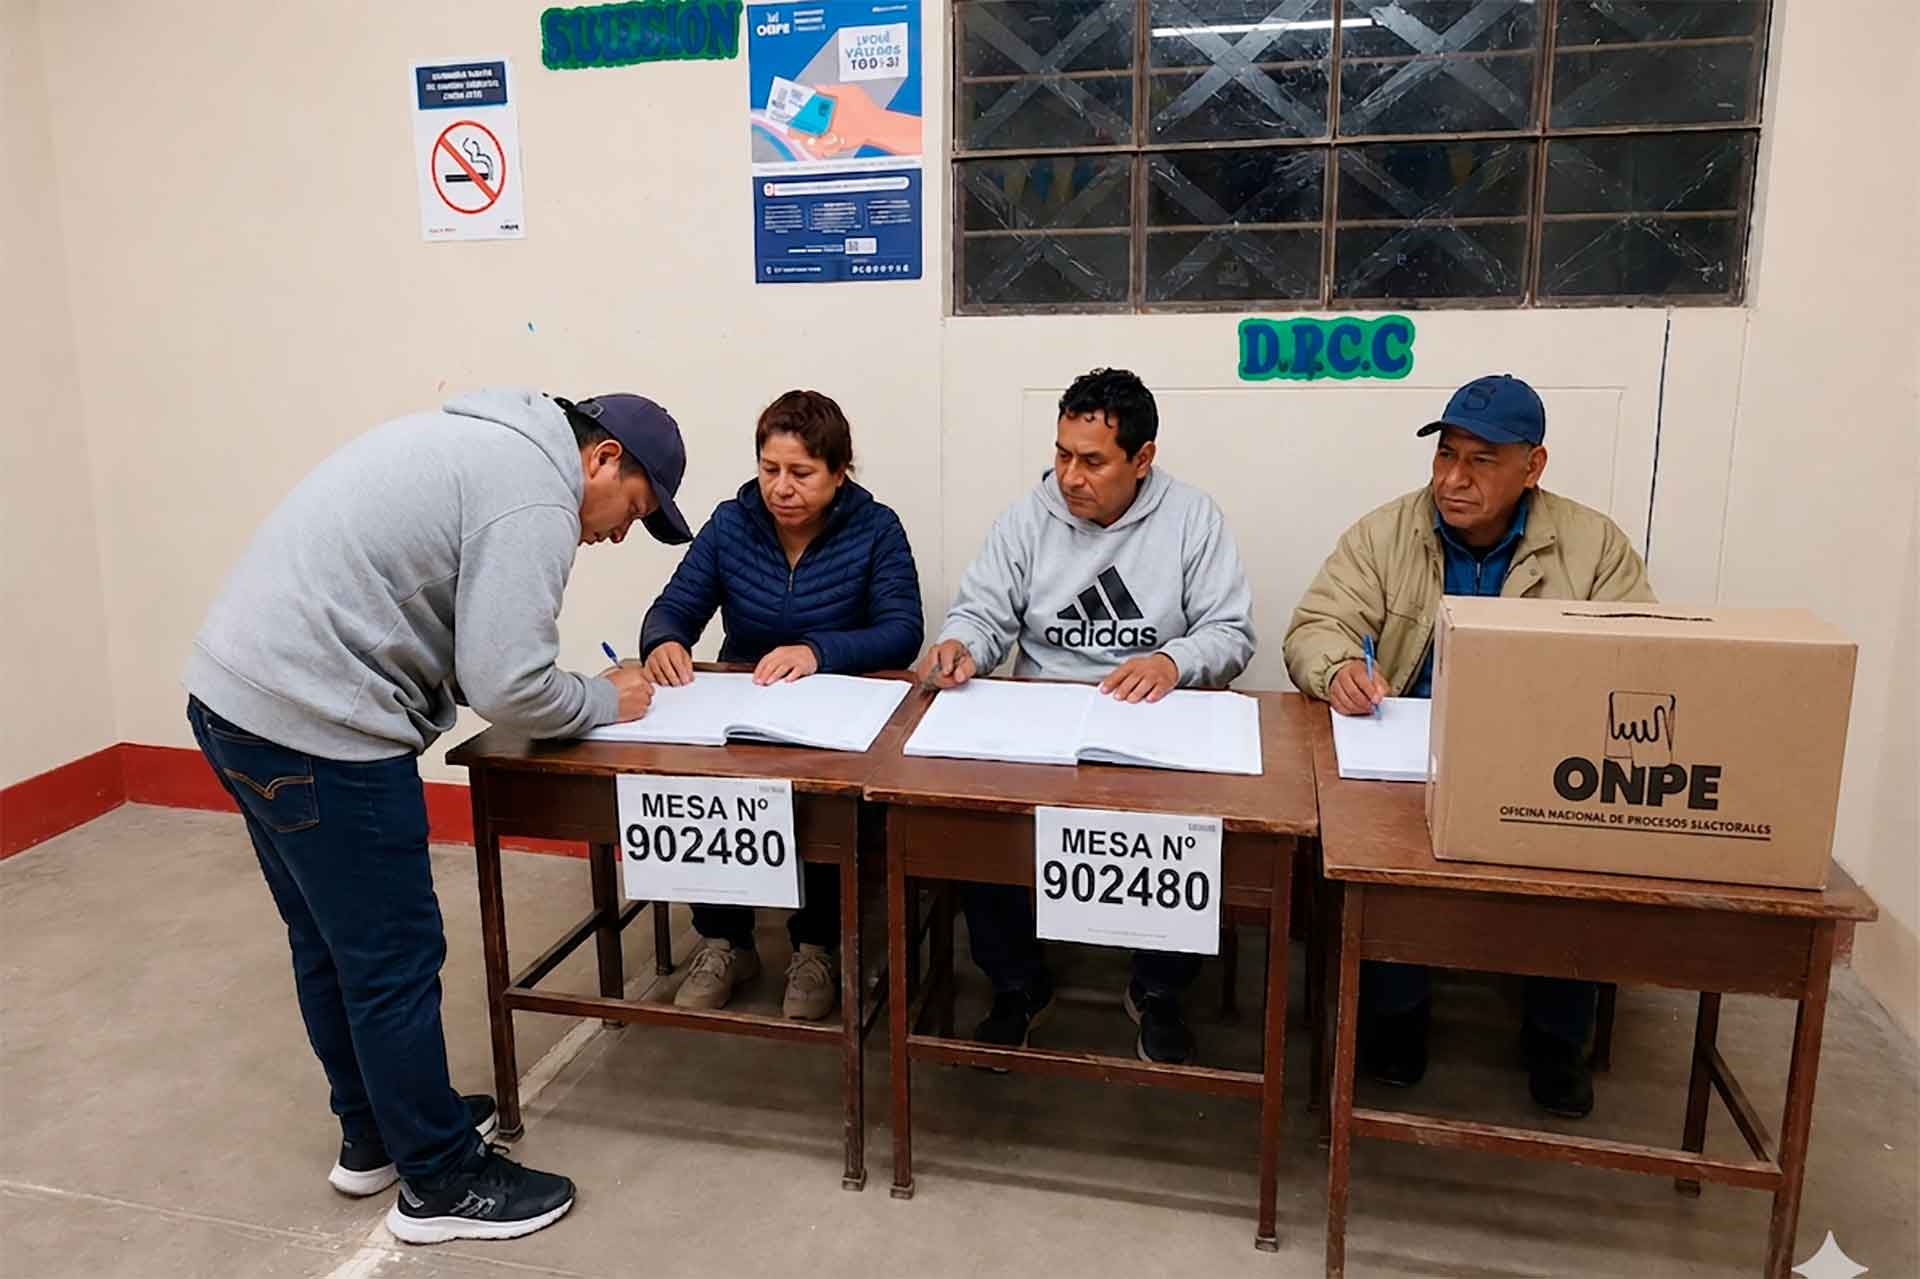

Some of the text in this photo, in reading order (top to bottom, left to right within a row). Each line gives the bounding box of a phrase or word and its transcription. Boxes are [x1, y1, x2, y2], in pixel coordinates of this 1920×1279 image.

[1045, 620, 1157, 647] adidas
[1553, 757, 1722, 811] ONPE
[642, 793, 728, 820] MESA
[1500, 806, 1545, 819] OFICINA
[1548, 810, 1606, 823] NACIONAL
[1609, 814, 1624, 825] DE
[1627, 816, 1687, 829] PROCESOS
[626, 824, 785, 868] 902480
[1061, 828, 1153, 859] MESA
[1042, 860, 1210, 911] 902480
